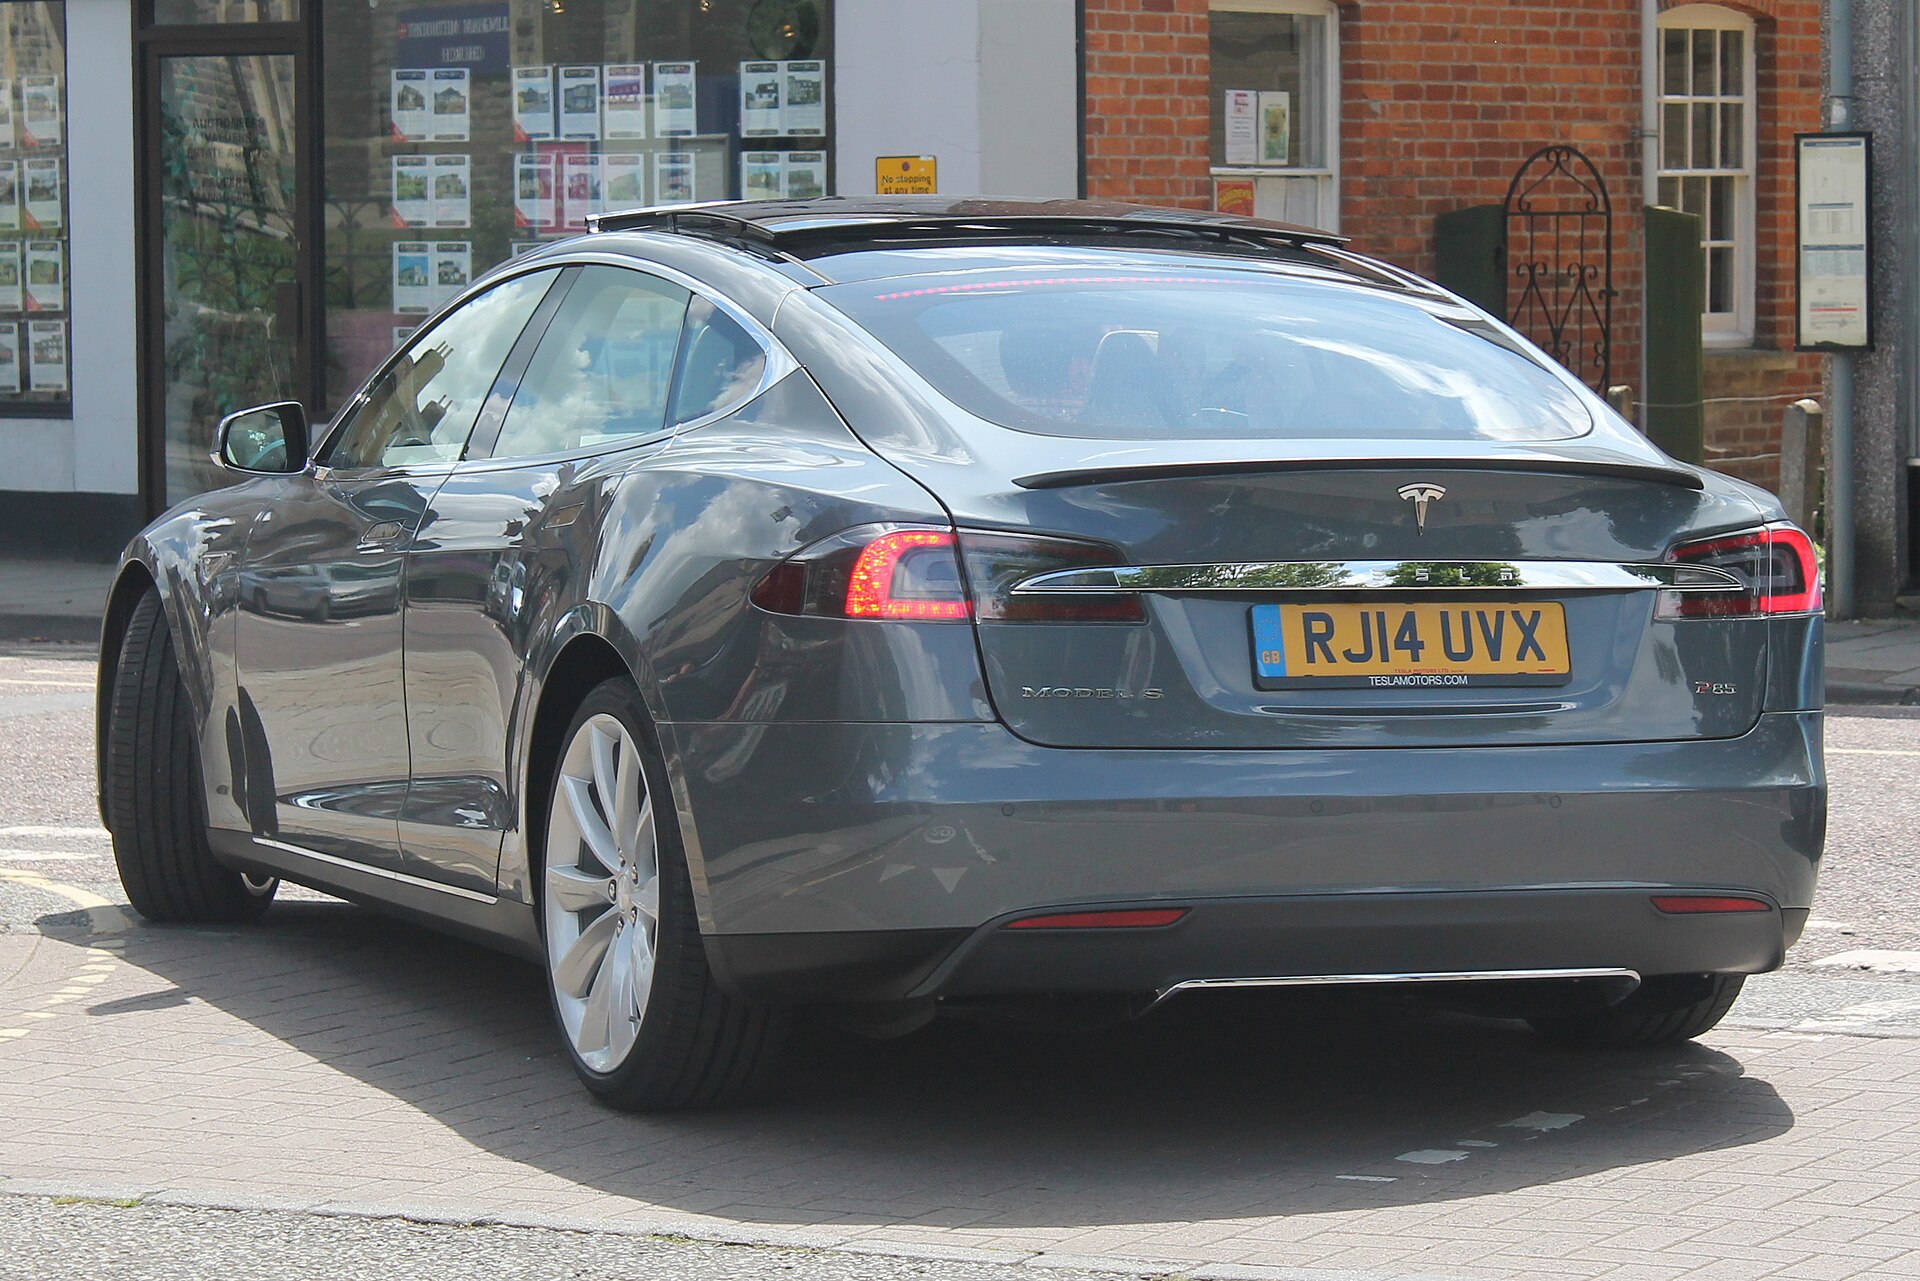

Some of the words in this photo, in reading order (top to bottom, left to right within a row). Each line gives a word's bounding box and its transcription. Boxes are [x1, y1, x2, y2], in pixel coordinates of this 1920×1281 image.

[882, 175, 893, 183] No
[895, 175, 931, 185] stopping
[884, 186, 892, 194] at
[911, 186, 930, 194] time
[1302, 611, 1425, 664] RJ14
[1439, 610, 1546, 662] UVX
[1262, 650, 1280, 665] GB
[1368, 675, 1468, 686] TESLAMOTORS.COM
[1022, 686, 1134, 698] MODEL
[1143, 688, 1164, 698] S
[1694, 681, 1737, 695] P85
